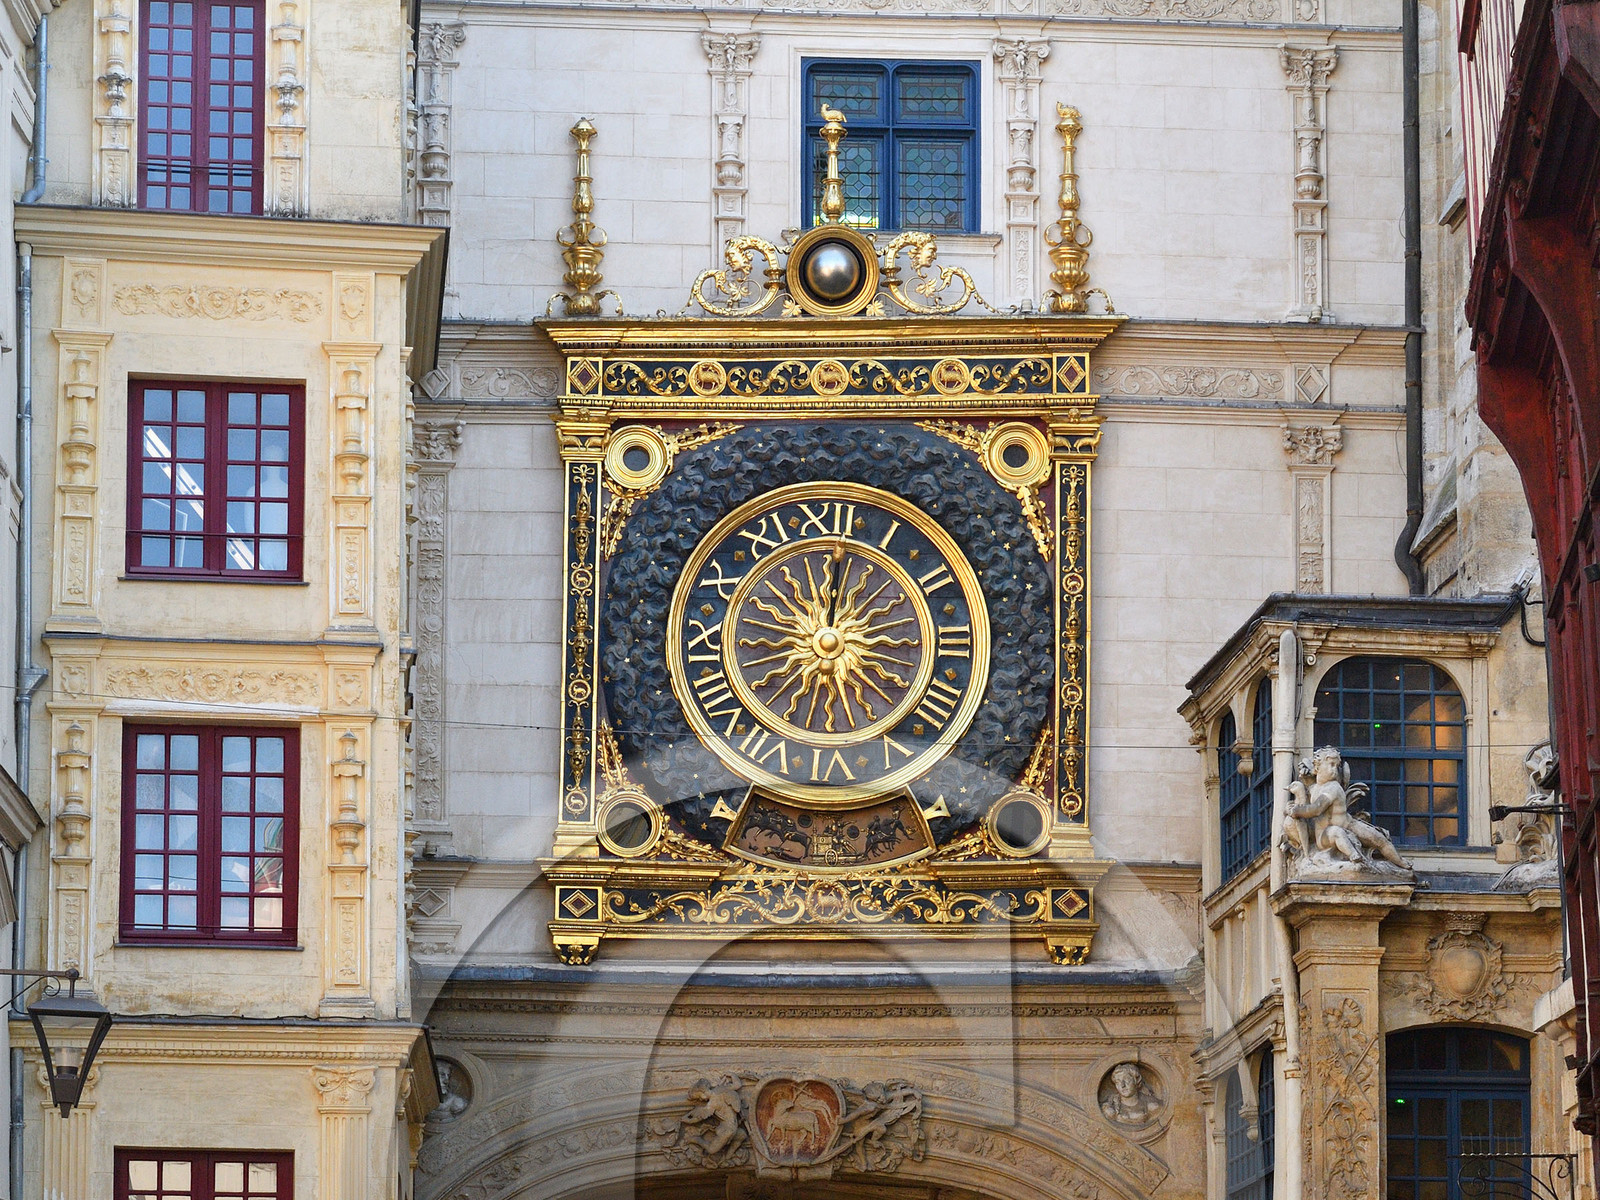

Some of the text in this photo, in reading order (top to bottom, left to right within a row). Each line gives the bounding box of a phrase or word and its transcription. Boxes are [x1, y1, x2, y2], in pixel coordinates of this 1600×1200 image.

[798, 502, 856, 537] XII
[938, 624, 971, 659] III
[810, 748, 856, 782] VI
